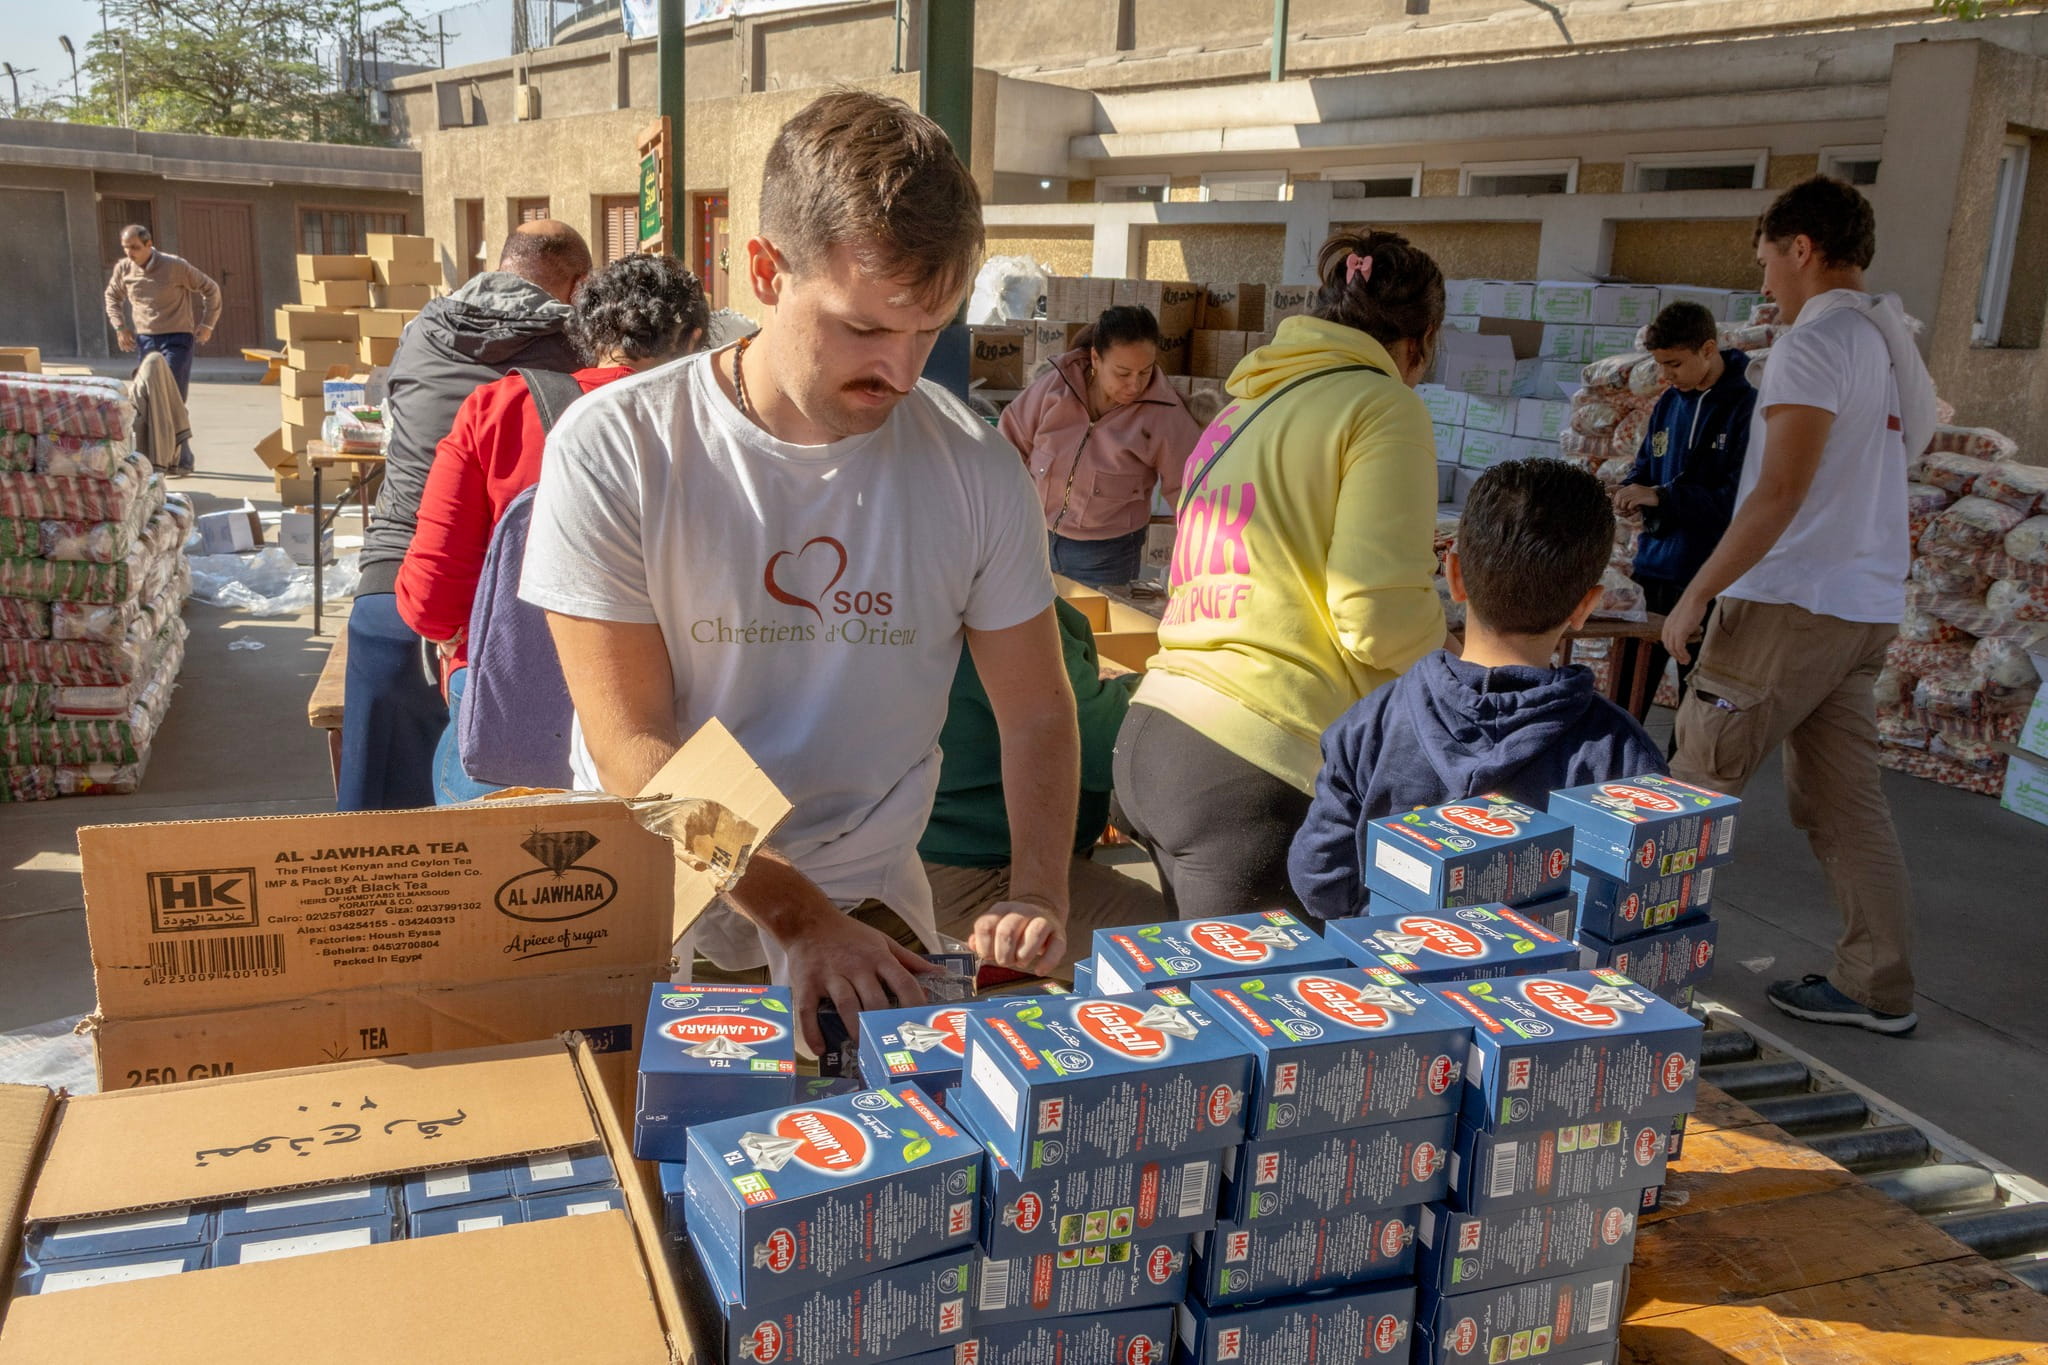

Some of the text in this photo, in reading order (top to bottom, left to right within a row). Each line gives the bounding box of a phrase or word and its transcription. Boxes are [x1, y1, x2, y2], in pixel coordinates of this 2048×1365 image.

[833, 591, 893, 616] SOS
[1190, 584, 1252, 622] PUFF
[691, 617, 815, 644] Chrétiens
[1606, 785, 1682, 808] الجوهرة
[1448, 806, 1512, 832] الجوهرة
[275, 842, 468, 863] AL JAWHARA TEA
[341, 863, 383, 872] Kenyan
[411, 859, 449, 868] Ceylon
[453, 857, 471, 865] Tea
[160, 876, 245, 909] HK
[265, 880, 287, 888] IMP
[303, 877, 330, 885] Pack
[335, 876, 348, 885] By
[371, 872, 417, 881] Jawhara
[325, 881, 427, 896] Dust Black Tea
[508, 884, 604, 906] AL JAWHARA
[164, 912, 244, 927] علامة الجودة
[268, 915, 302, 923] Cairo:
[385, 906, 413, 914] Giza:
[297, 926, 326, 934] Alex:
[310, 935, 365, 945] Factories:
[369, 932, 406, 941] Housh
[503, 929, 608, 953] A piece of sugar
[1200, 924, 1262, 957] الجوهرة
[1404, 919, 1475, 952] الجوهرة
[334, 957, 374, 967] Packed
[391, 954, 422, 965] Egypt
[159, 972, 215, 984] 223009
[224, 969, 279, 979] 400105
[1306, 980, 1383, 1024] الجوهرة
[1532, 982, 1613, 1023] الجوهرة
[360, 1028, 388, 1050] TEA
[677, 1024, 768, 1036] AL JAWHARA
[881, 1034, 899, 1045] TEA
[1086, 1006, 1161, 1050] الجوهرة
[709, 1059, 731, 1068] TEA
[753, 1062, 777, 1070] 50
[827, 1052, 838, 1066] TEA
[1281, 1065, 1296, 1090] HK
[1431, 1059, 1447, 1090] الجوهرة
[1514, 1060, 1528, 1085] HK
[1665, 1057, 1680, 1088] الجوهرة
[908, 1097, 944, 1129] THE FINEST TEA
[1045, 1100, 1061, 1127] HK
[1211, 1088, 1228, 1121] الجوهرة
[195, 1109, 467, 1167] نموذج رقم
[792, 1114, 841, 1150] JAWHARA
[724, 1151, 744, 1165] TEA
[824, 1150, 852, 1164] AL
[1263, 1154, 1276, 1180] HK
[1415, 1146, 1429, 1177] الجوهرة
[736, 1176, 760, 1192] 50
[950, 1204, 964, 1233] HK
[1019, 1196, 1035, 1228] الجوهرة
[1234, 1233, 1247, 1255] HK
[1384, 1223, 1397, 1253] الجوهرة
[1465, 1223, 1480, 1247] HK
[773, 1231, 789, 1268] الجوهرة
[1153, 1249, 1166, 1280] الجوهرة
[941, 1301, 956, 1330] HK
[758, 1323, 776, 1360] الجوهرة
[1224, 1330, 1239, 1356] HK
[1380, 1318, 1392, 1347] الجوهرة
